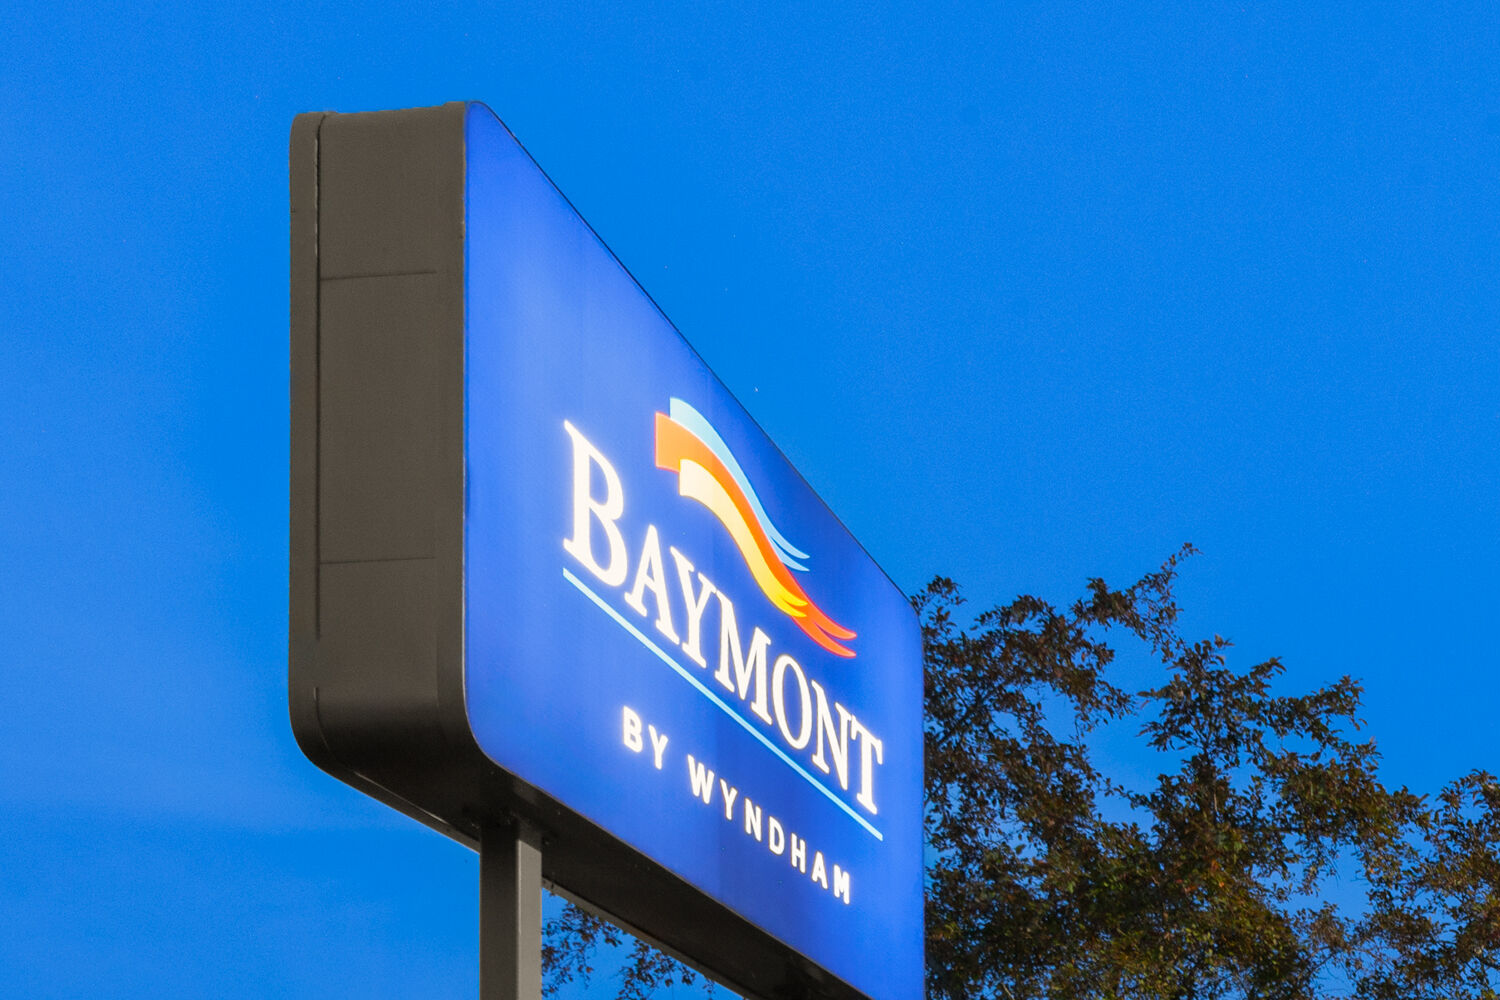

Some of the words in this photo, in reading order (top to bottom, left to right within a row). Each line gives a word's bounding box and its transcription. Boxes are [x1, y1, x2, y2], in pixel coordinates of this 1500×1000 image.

[563, 419, 884, 815] BAYMONT
[622, 705, 669, 770] BY
[687, 754, 851, 905] WYNDHAM
